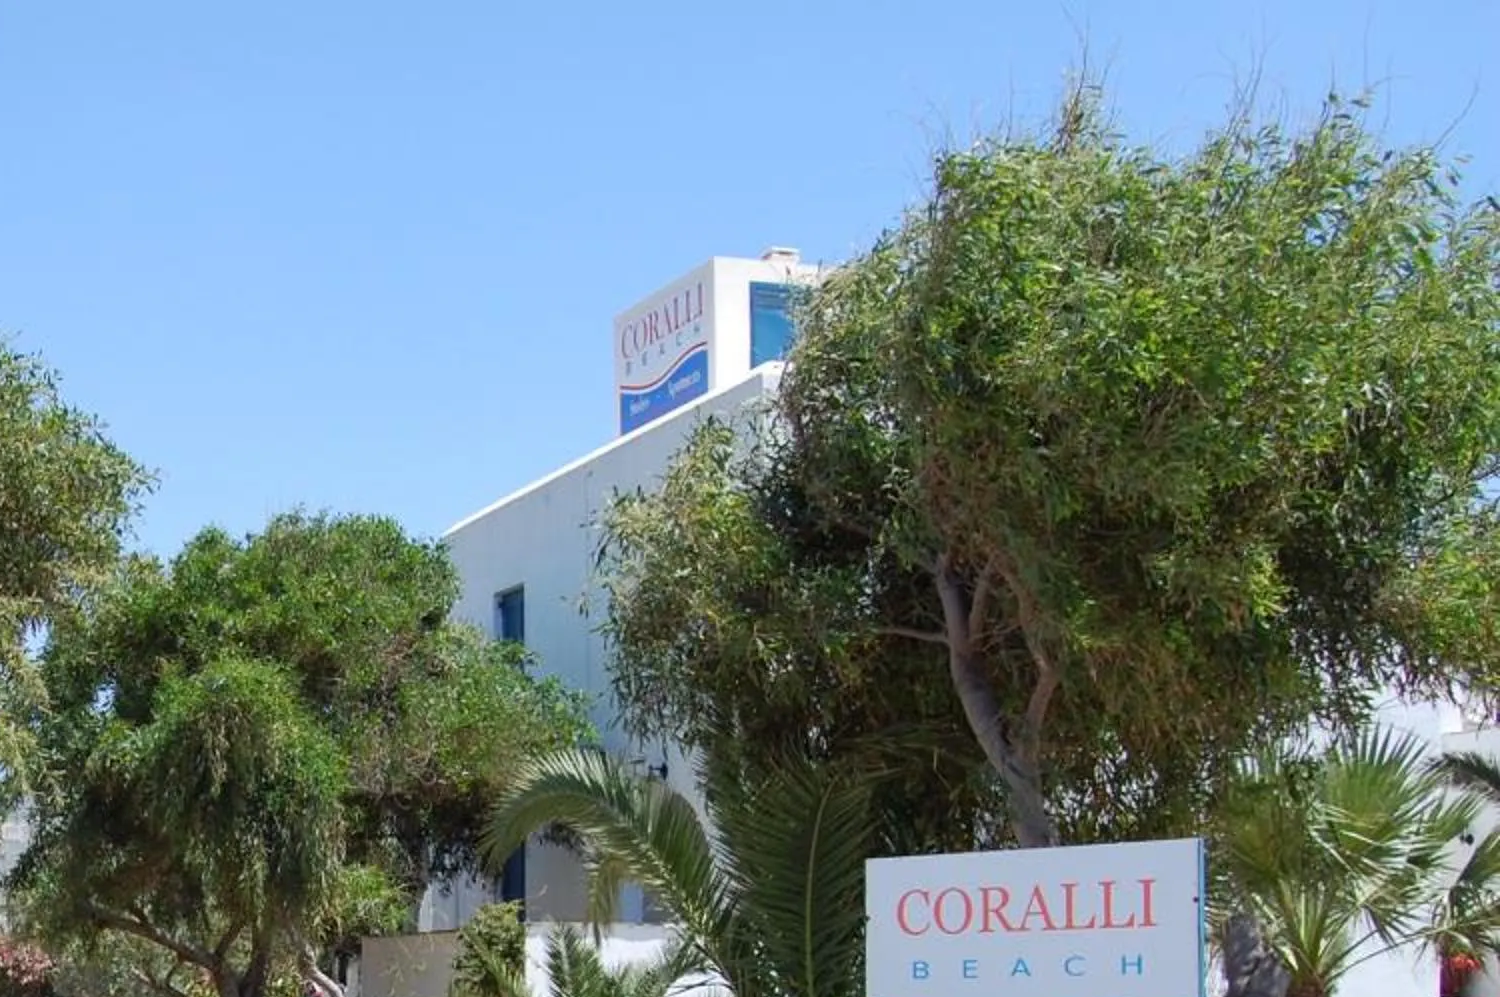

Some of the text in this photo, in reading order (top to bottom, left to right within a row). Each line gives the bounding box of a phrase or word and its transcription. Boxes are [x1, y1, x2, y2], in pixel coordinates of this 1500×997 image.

[621, 282, 704, 359] CORALLI
[896, 878, 1157, 936] CORALLI
[912, 954, 1144, 979] BEACH
